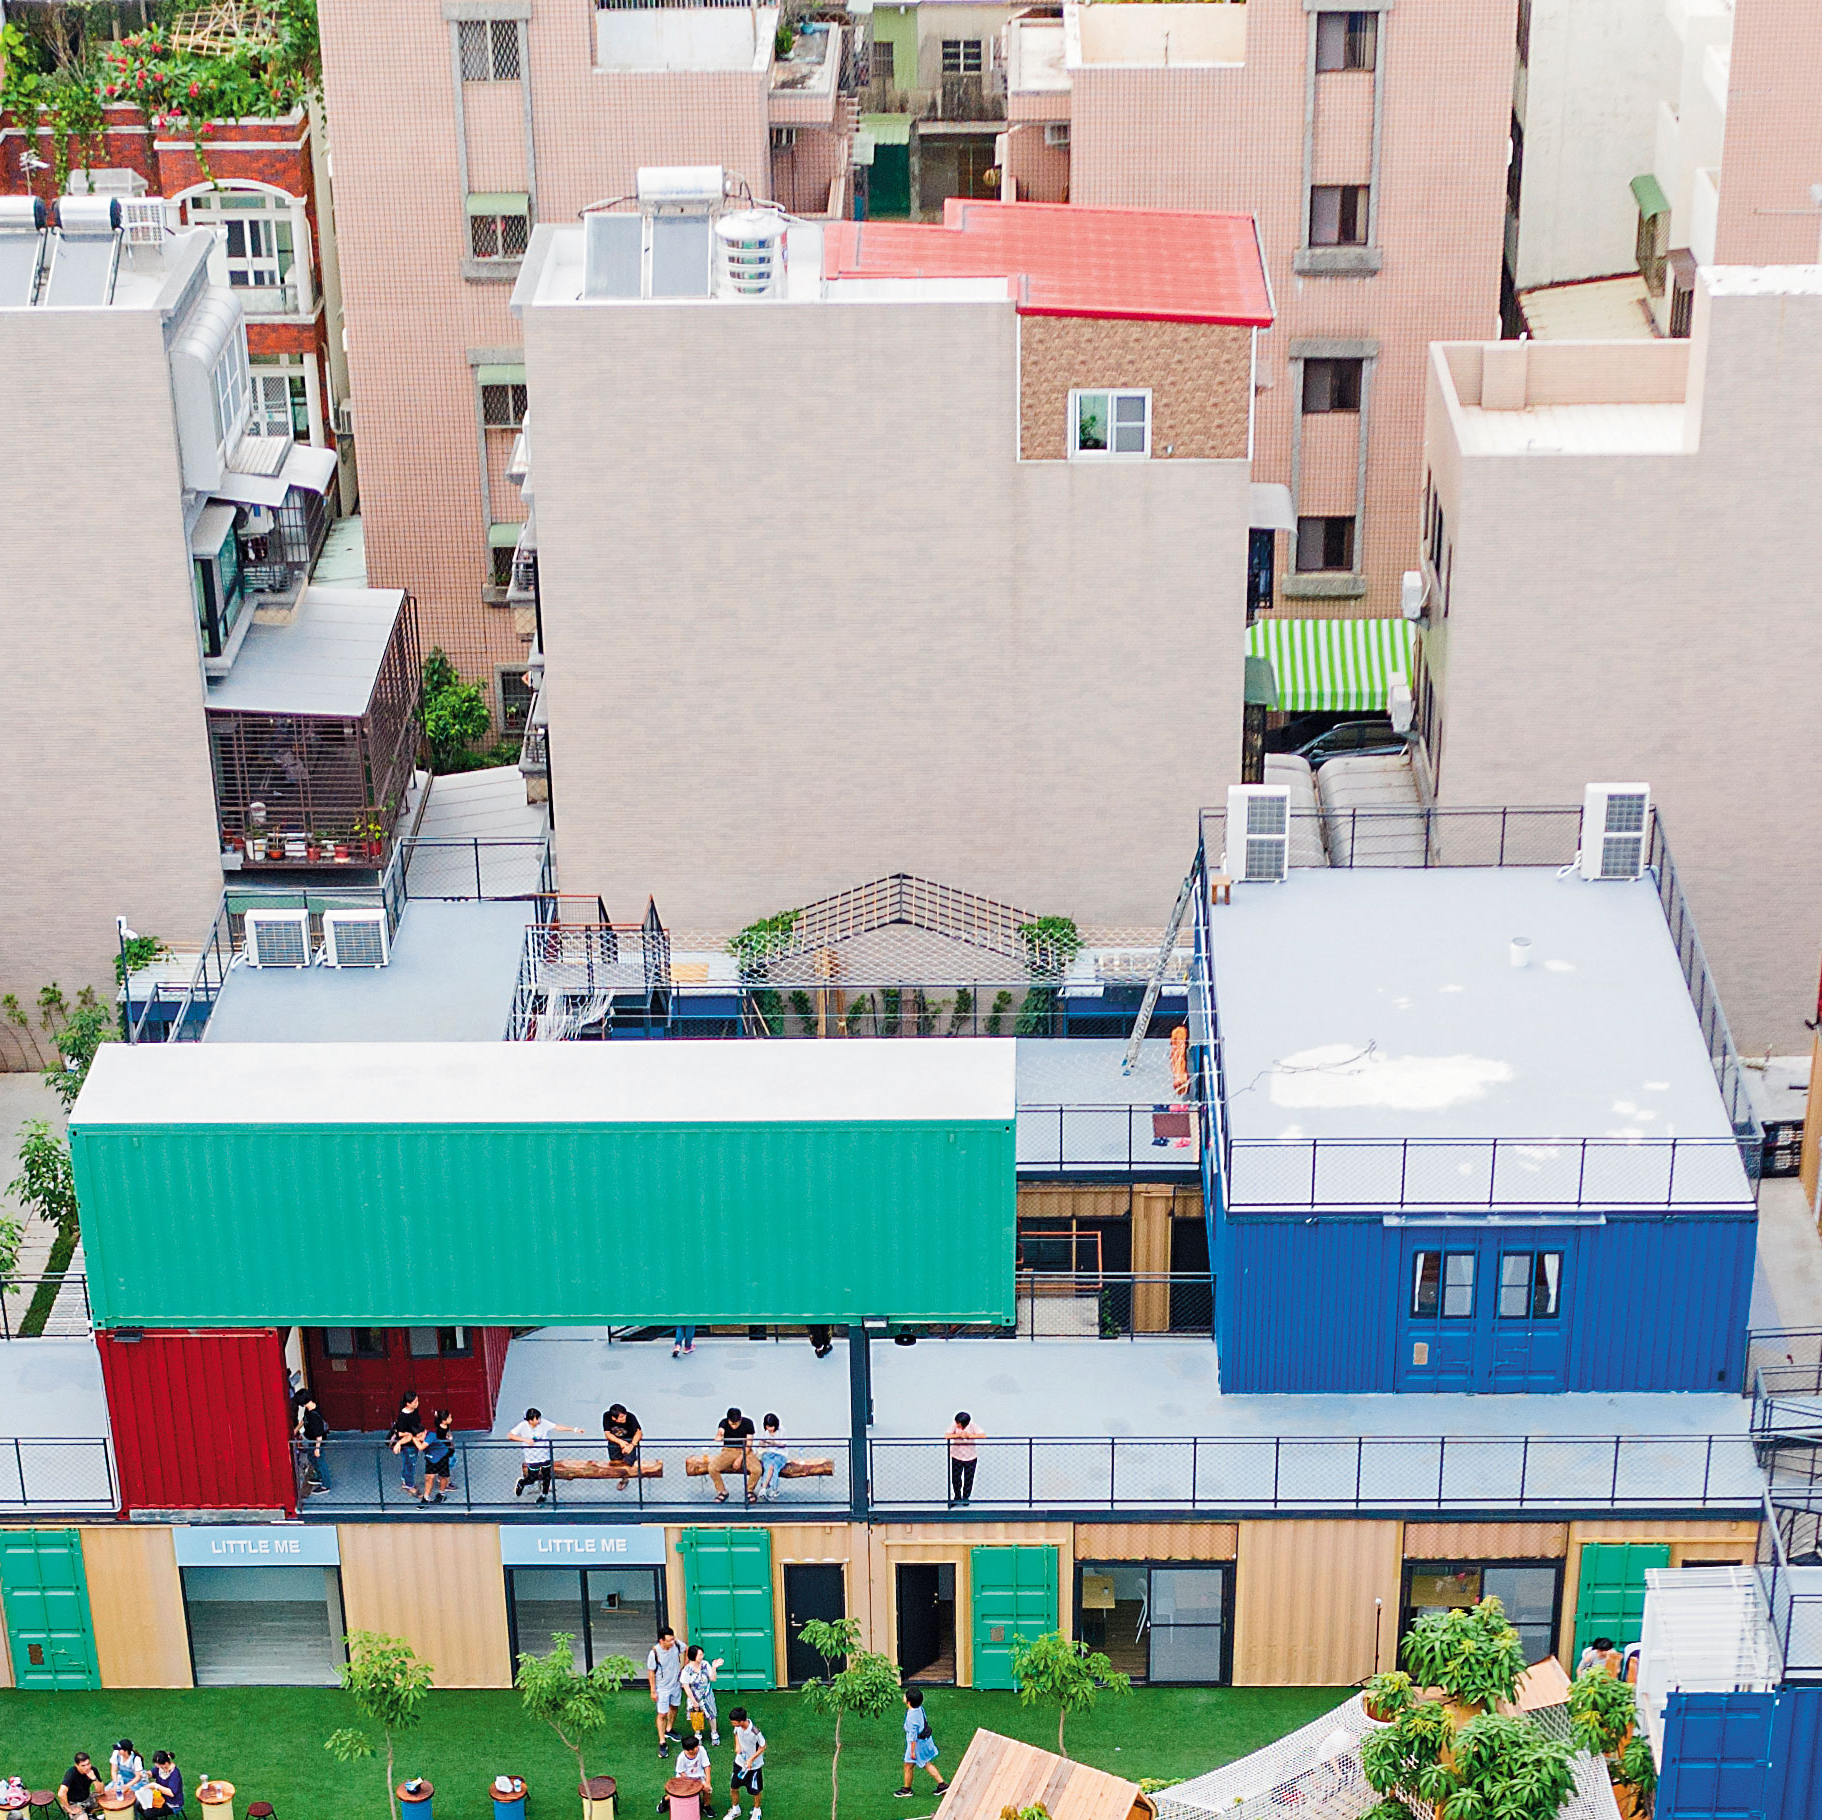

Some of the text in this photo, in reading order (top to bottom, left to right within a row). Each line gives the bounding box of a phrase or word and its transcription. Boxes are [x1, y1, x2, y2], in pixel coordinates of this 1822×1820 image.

[211, 1539, 301, 1554] LITTLE ME
[537, 1538, 627, 1553] LITTLE ME
